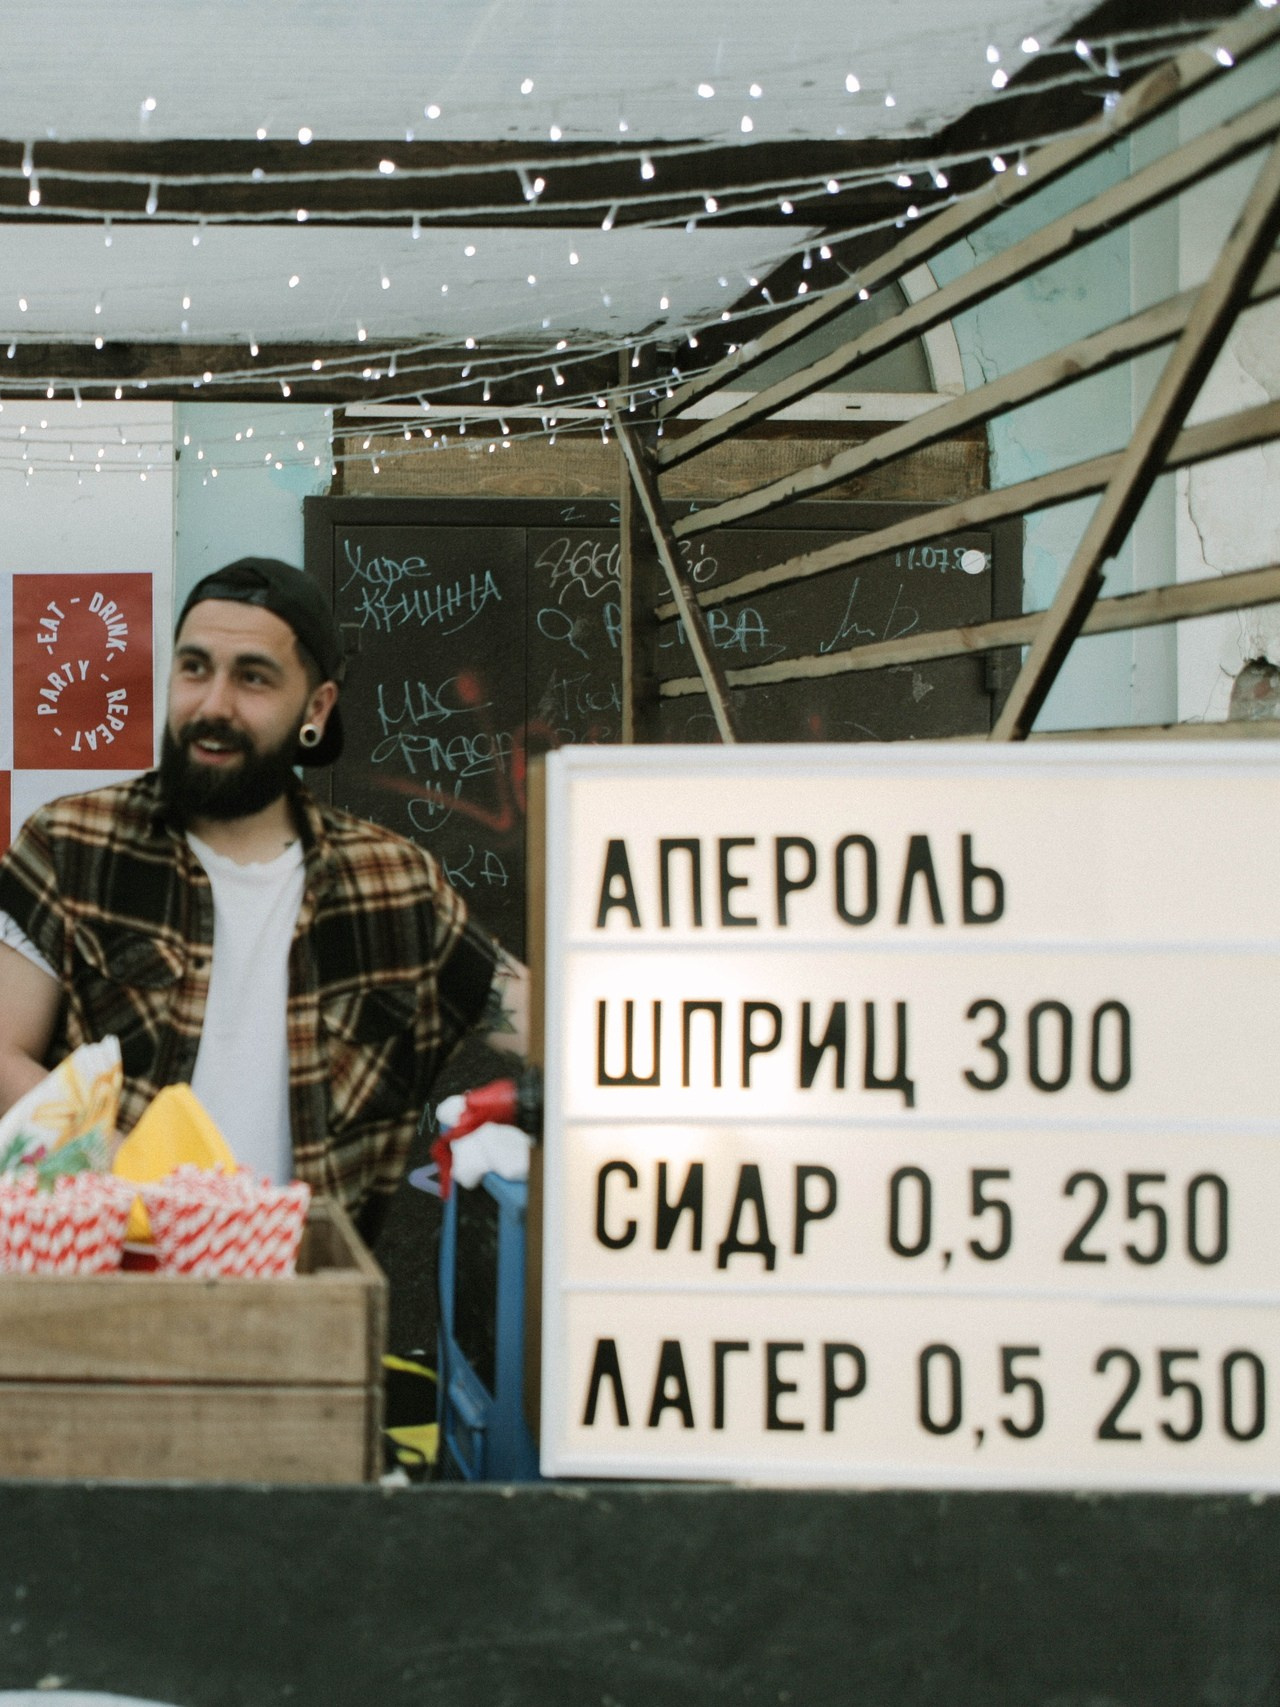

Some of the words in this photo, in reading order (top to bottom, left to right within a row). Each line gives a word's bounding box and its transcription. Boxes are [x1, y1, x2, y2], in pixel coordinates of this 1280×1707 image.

[37, 601, 65, 643] EAT
[89, 592, 128, 652] DRINK
[37, 660, 89, 715] PARTY
[71, 688, 128, 752] REPEAT
[595, 833, 1005, 928] АПЕРОЛЬ
[596, 999, 915, 1107] ШПРИЦ
[963, 999, 1132, 1092] 300
[595, 1159, 838, 1271] СИДР
[888, 1165, 1012, 1270] 0,5
[1060, 1171, 1230, 1266] 250
[582, 1338, 868, 1433] ЛАГЕР
[920, 1343, 1045, 1448] 0,5
[1093, 1347, 1267, 1443] 250
